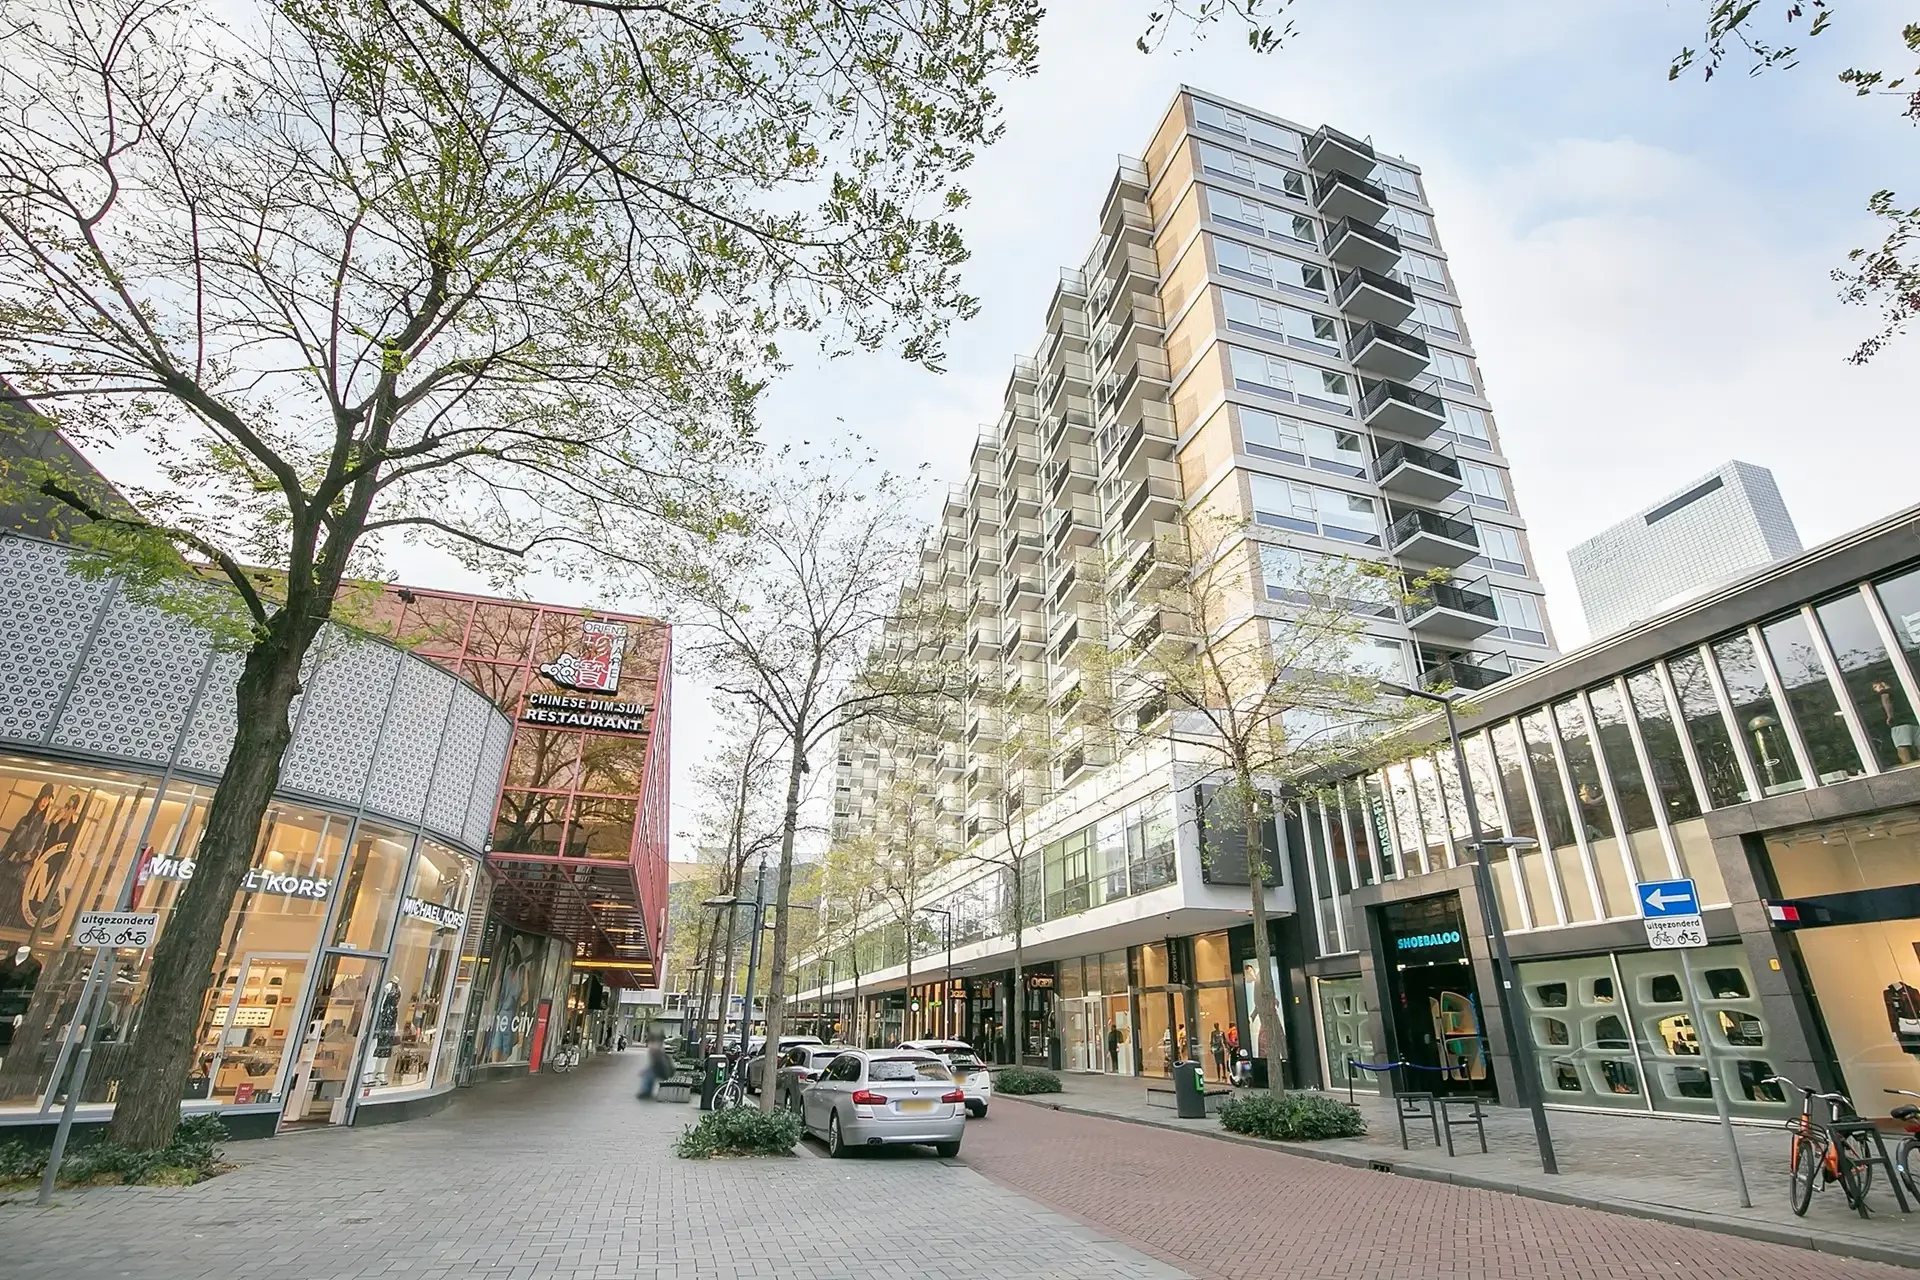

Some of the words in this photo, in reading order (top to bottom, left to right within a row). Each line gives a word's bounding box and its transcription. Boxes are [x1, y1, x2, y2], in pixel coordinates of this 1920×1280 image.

[584, 622, 627, 635] ORIENT
[529, 693, 587, 709] CHINESE
[590, 701, 614, 712] DIM
[617, 703, 645, 715] SUM
[525, 708, 642, 731] RESTAURANT
[150, 856, 258, 889] MICL
[266, 874, 328, 898] KORS
[82, 915, 155, 927] uitgezonderd
[403, 898, 441, 921] MICHAEL
[442, 909, 465, 928] KORS
[1647, 919, 1700, 931] uitgezonderd
[1397, 931, 1460, 949] SHOEBALOO
[511, 1011, 534, 1037] city
